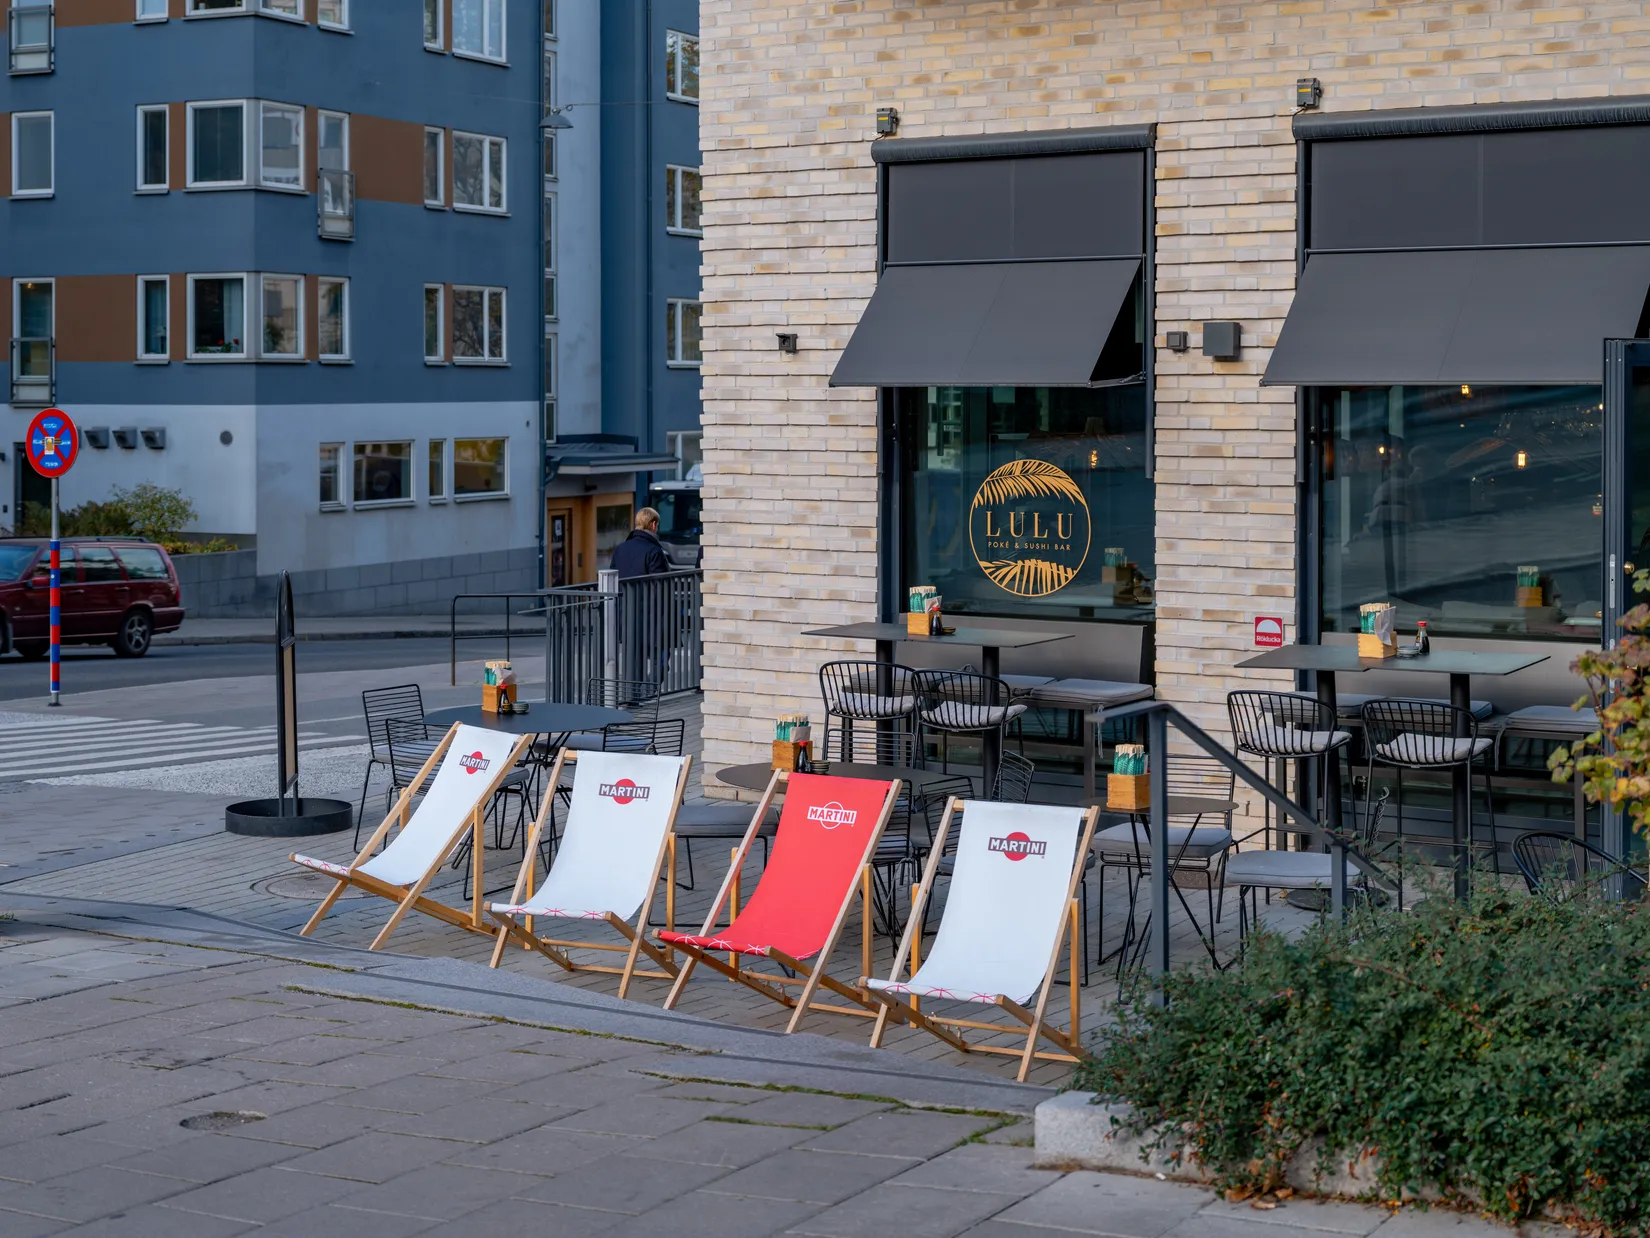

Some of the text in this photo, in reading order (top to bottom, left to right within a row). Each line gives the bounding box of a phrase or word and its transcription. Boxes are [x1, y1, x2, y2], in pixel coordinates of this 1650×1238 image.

[985, 511, 1073, 539] LULU
[988, 541, 1010, 549] POKÉ
[460, 755, 489, 770] MARTINI
[600, 785, 648, 798] MARTINI
[809, 807, 855, 822] MARTINI
[990, 838, 1045, 854] MARTINI
